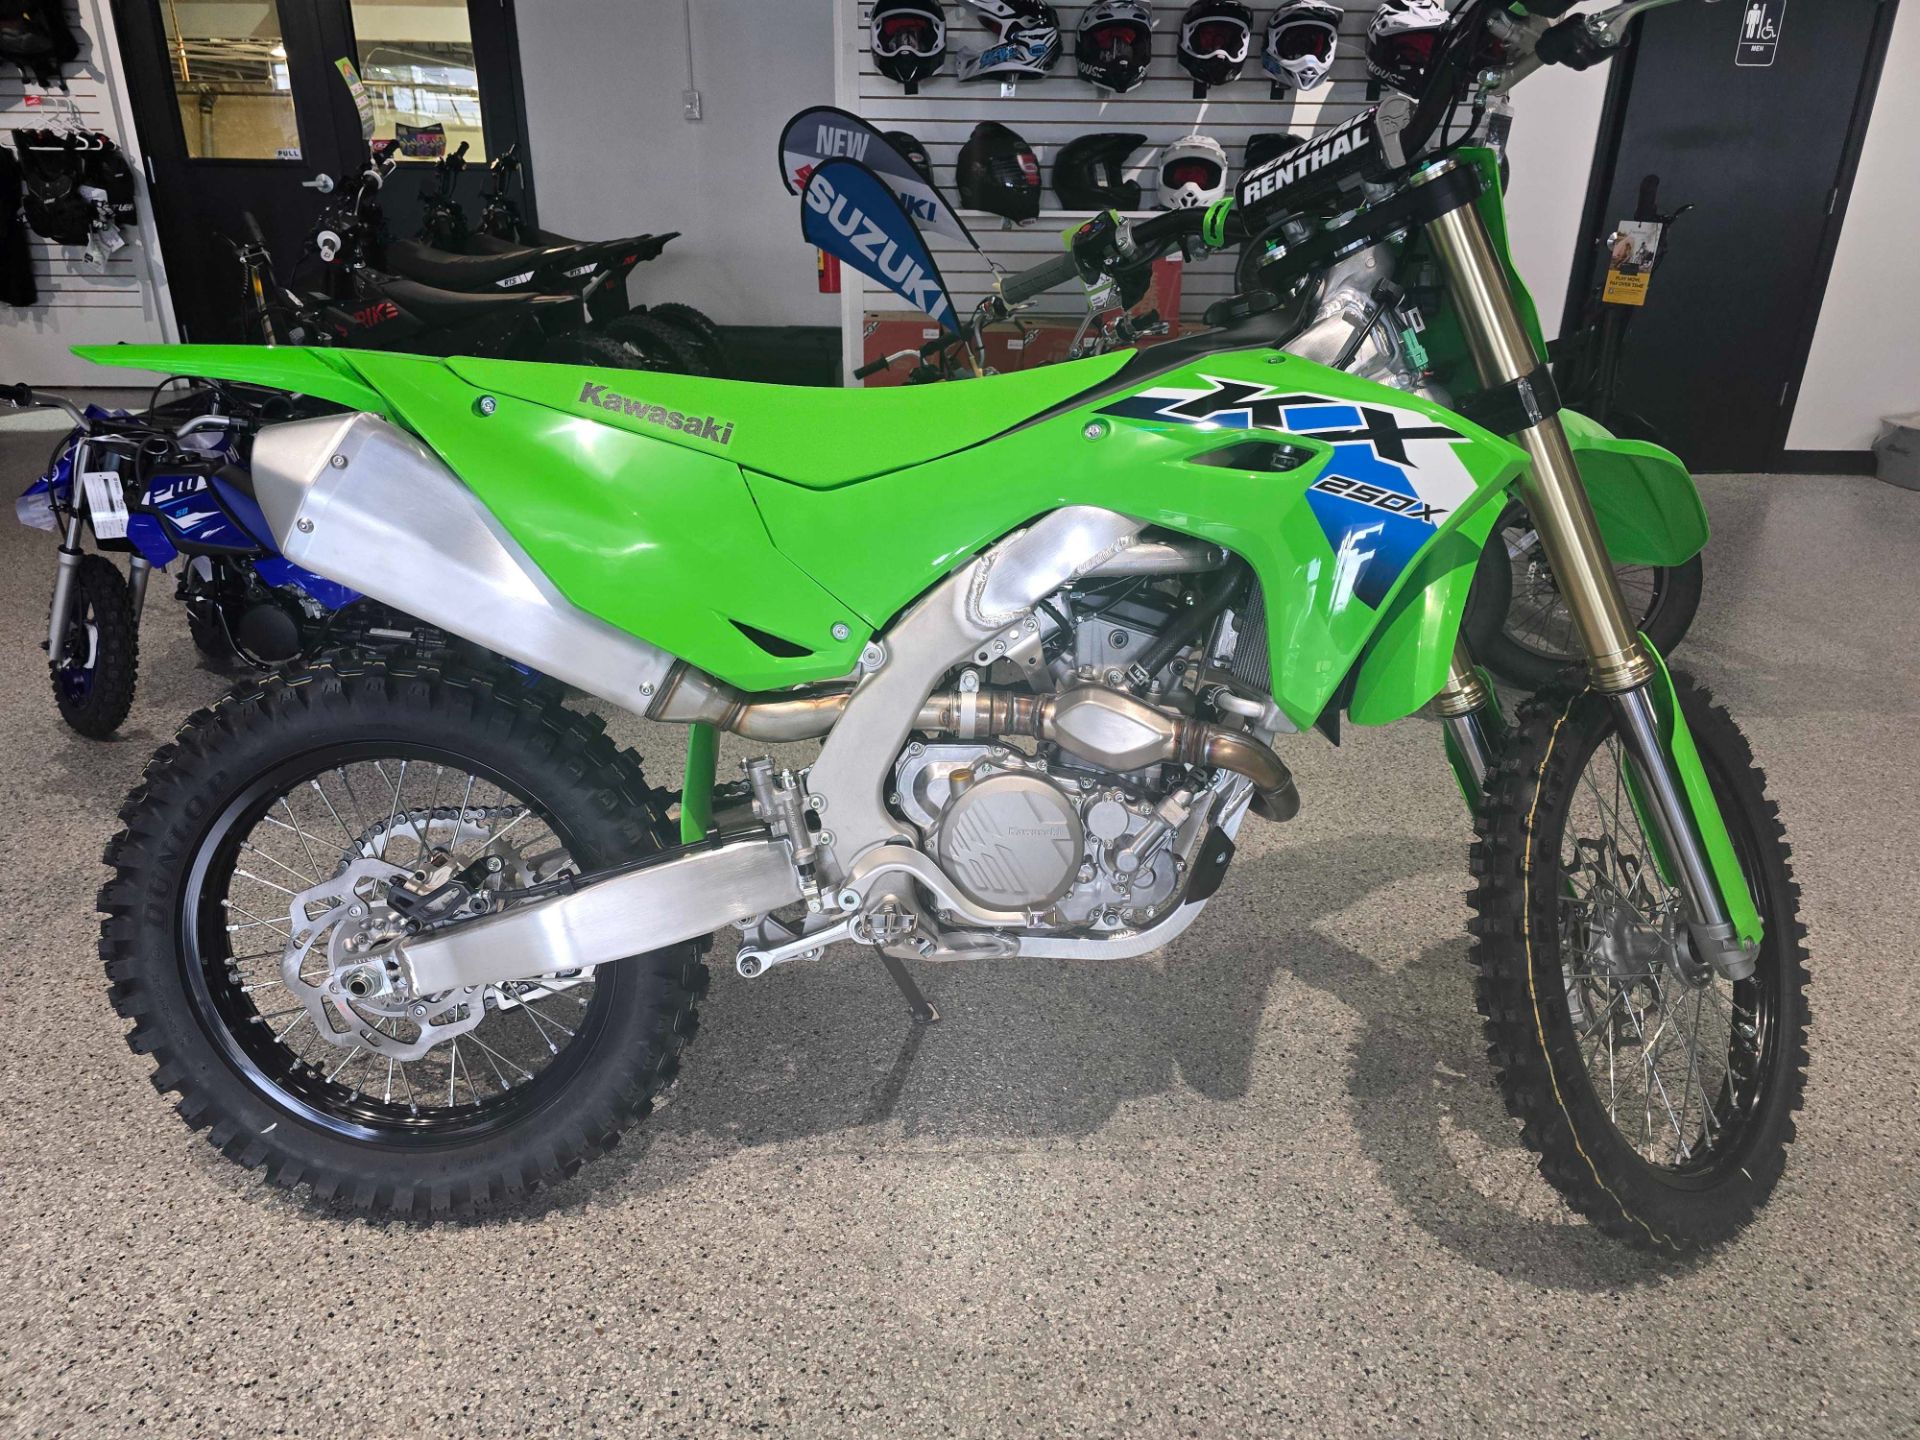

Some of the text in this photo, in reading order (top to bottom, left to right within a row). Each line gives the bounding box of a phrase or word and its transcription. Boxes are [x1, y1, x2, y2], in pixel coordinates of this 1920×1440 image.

[816, 124, 870, 161] NEW
[1243, 126, 1370, 207] RENTHAL
[806, 173, 948, 320] SUZUKI
[504, 277, 517, 287] RTS
[579, 382, 735, 445] Kawasaki
[1165, 380, 1468, 469] KX
[175, 507, 189, 518] 50
[146, 769, 229, 935] DUNLOP
[1008, 826, 1062, 837] Kawasaki
